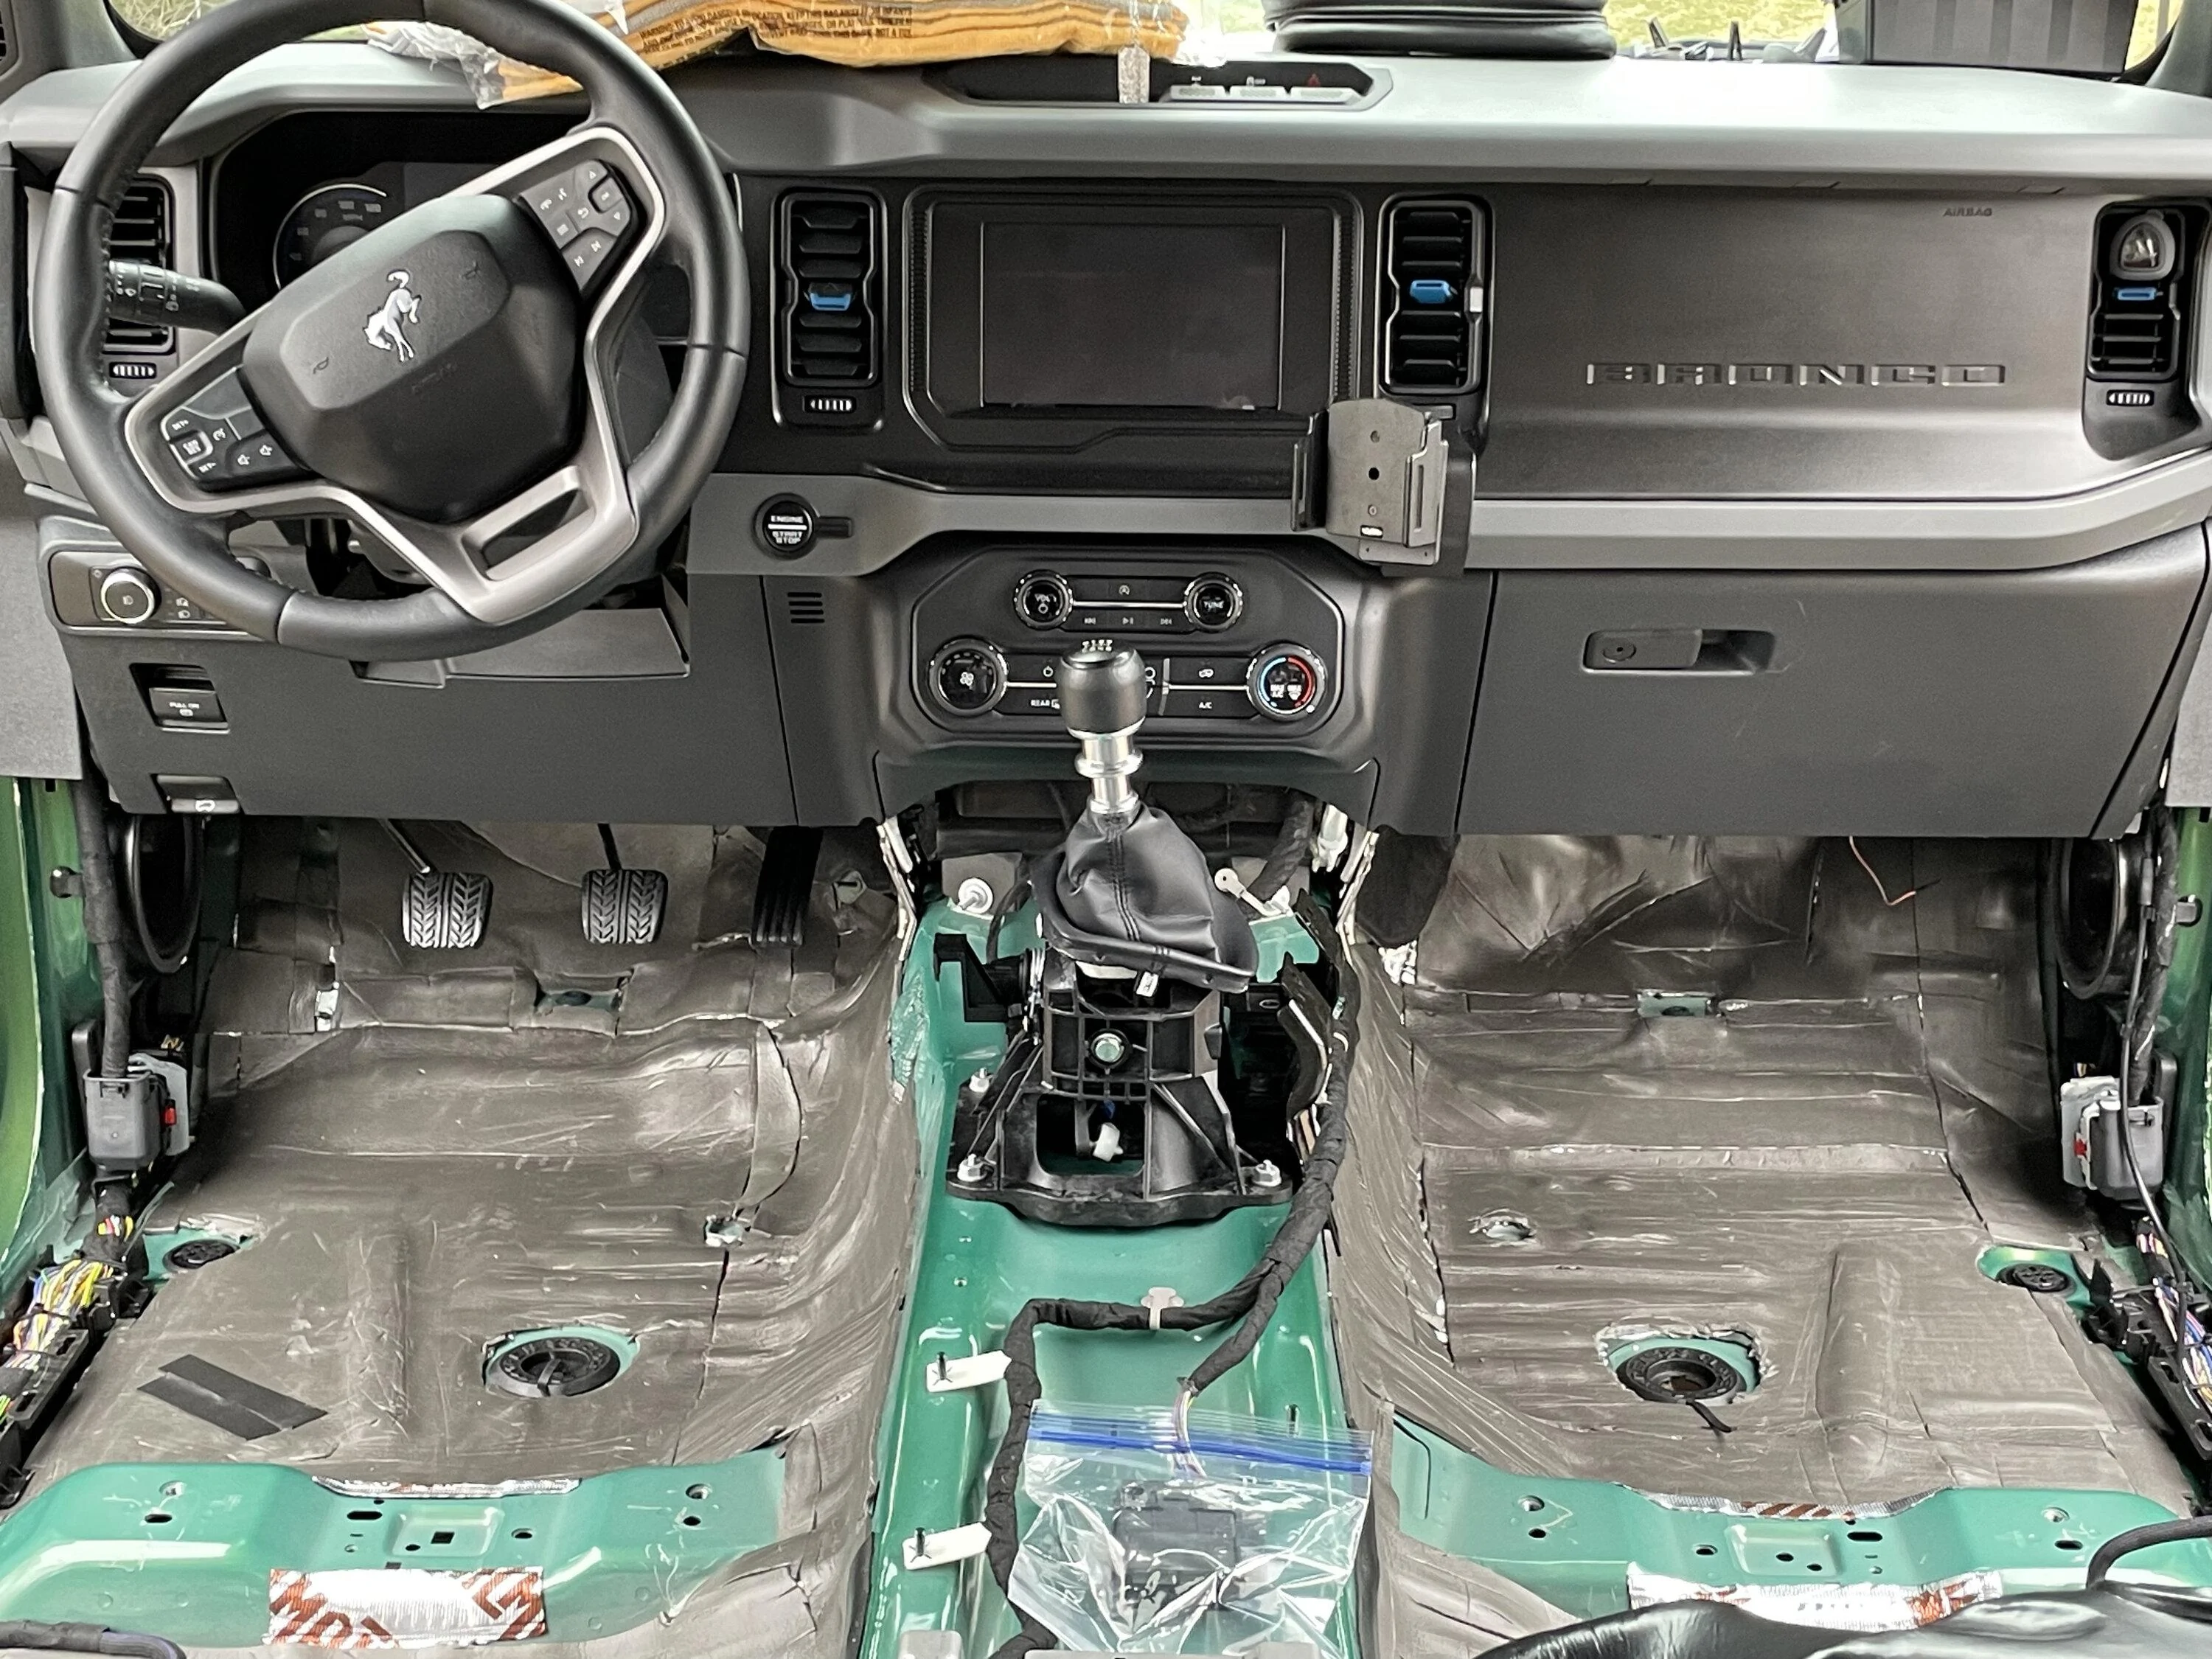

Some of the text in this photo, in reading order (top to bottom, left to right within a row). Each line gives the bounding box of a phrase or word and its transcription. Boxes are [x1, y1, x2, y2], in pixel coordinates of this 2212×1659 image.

[1942, 207, 1993, 217] AIRBAG
[1585, 362, 2006, 386] BRONCO
[771, 515, 803, 524] ENGINE
